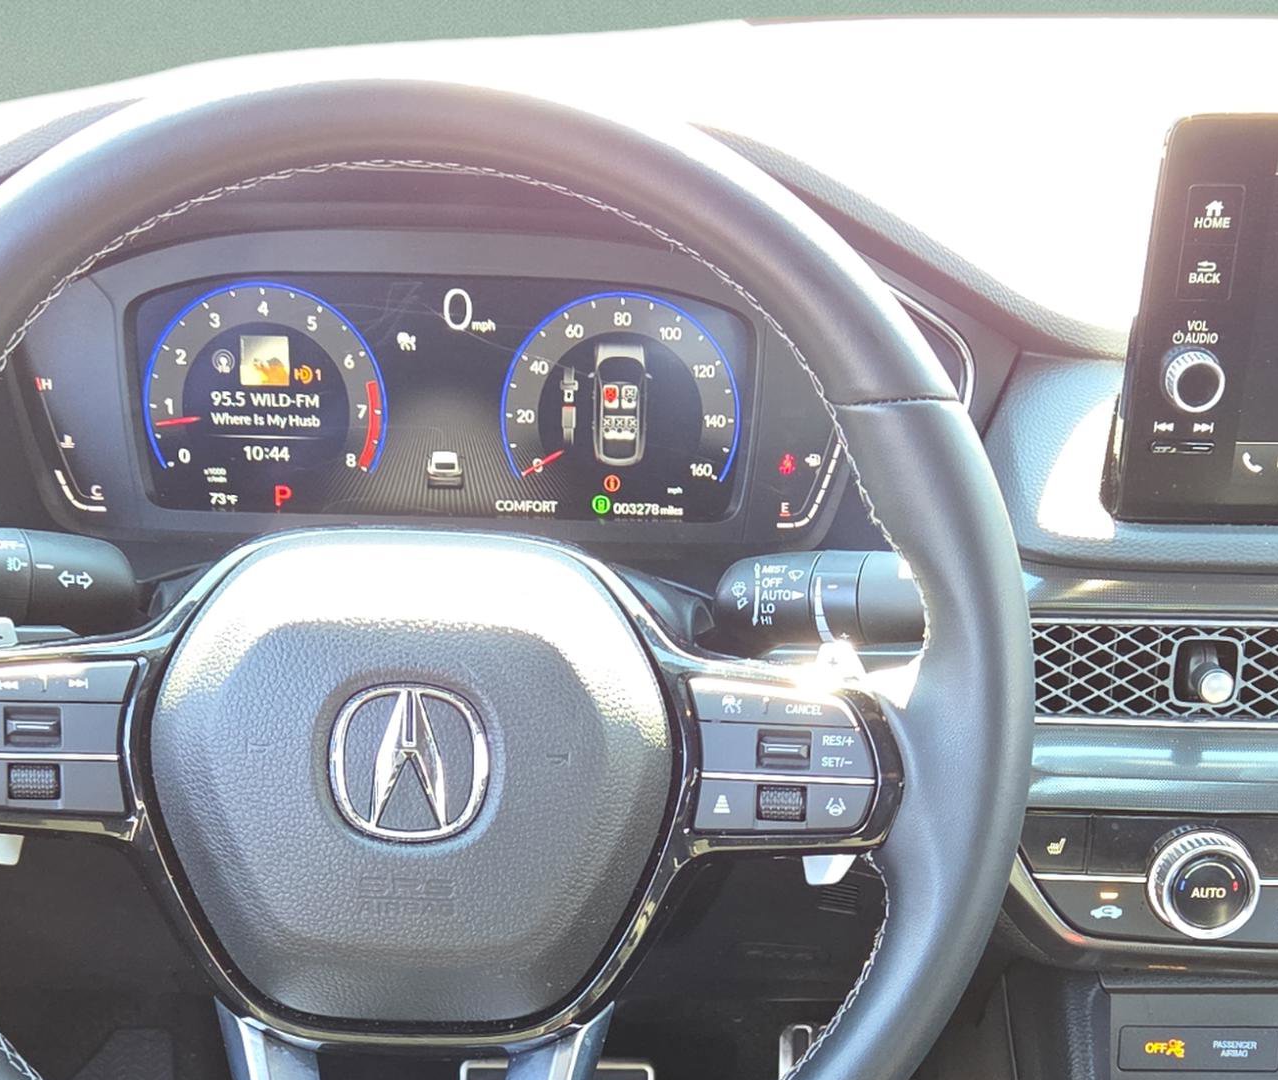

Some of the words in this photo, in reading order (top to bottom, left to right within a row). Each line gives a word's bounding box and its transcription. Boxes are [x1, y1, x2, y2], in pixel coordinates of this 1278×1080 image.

[1193, 217, 1231, 229] HOME
[1188, 272, 1221, 284] BACK
[257, 302, 269, 316] 4
[443, 288, 473, 331] 0
[471, 320, 496, 333] mph
[209, 313, 221, 328] 3
[306, 316, 318, 331] 5
[613, 312, 632, 326] 80
[565, 323, 585, 338] 60
[1187, 320, 1209, 332] VOL
[659, 327, 682, 341] 100
[1184, 332, 1218, 344] AUDIO
[175, 349, 188, 365] 2
[343, 354, 355, 369] 6
[529, 361, 549, 374] 40
[693, 364, 716, 378] 120
[40, 378, 52, 390] H
[165, 398, 173, 414] 1
[211, 391, 246, 407] 95.5
[250, 393, 320, 408] WILD-FM
[356, 404, 367, 419] 7
[516, 409, 535, 423] 20
[211, 412, 252, 426] Where
[253, 413, 265, 426] Is
[267, 413, 287, 428] My
[289, 414, 321, 427] Husb
[703, 414, 727, 428] 140
[178, 448, 191, 463] 0
[243, 446, 290, 462] 10:44
[345, 453, 356, 468] 8
[690, 463, 712, 477] 160
[90, 484, 103, 496] C
[274, 485, 292, 506] P
[495, 500, 558, 512] COMFORT
[613, 503, 660, 516] 003278
[660, 504, 684, 516] miles
[781, 502, 790, 513] E
[762, 565, 788, 574] MIST
[762, 578, 783, 588] OFF
[761, 590, 791, 601] AUTO
[761, 604, 775, 614] LO
[761, 615, 773, 625] HI
[785, 704, 823, 716] CANCEL
[822, 735, 854, 747] RES/+
[1191, 887, 1226, 900] AUTO
[1145, 1042, 1168, 1055] OFF
[1213, 1040, 1257, 1049] PASSENGER
[1220, 1049, 1248, 1058] AIRBAG
